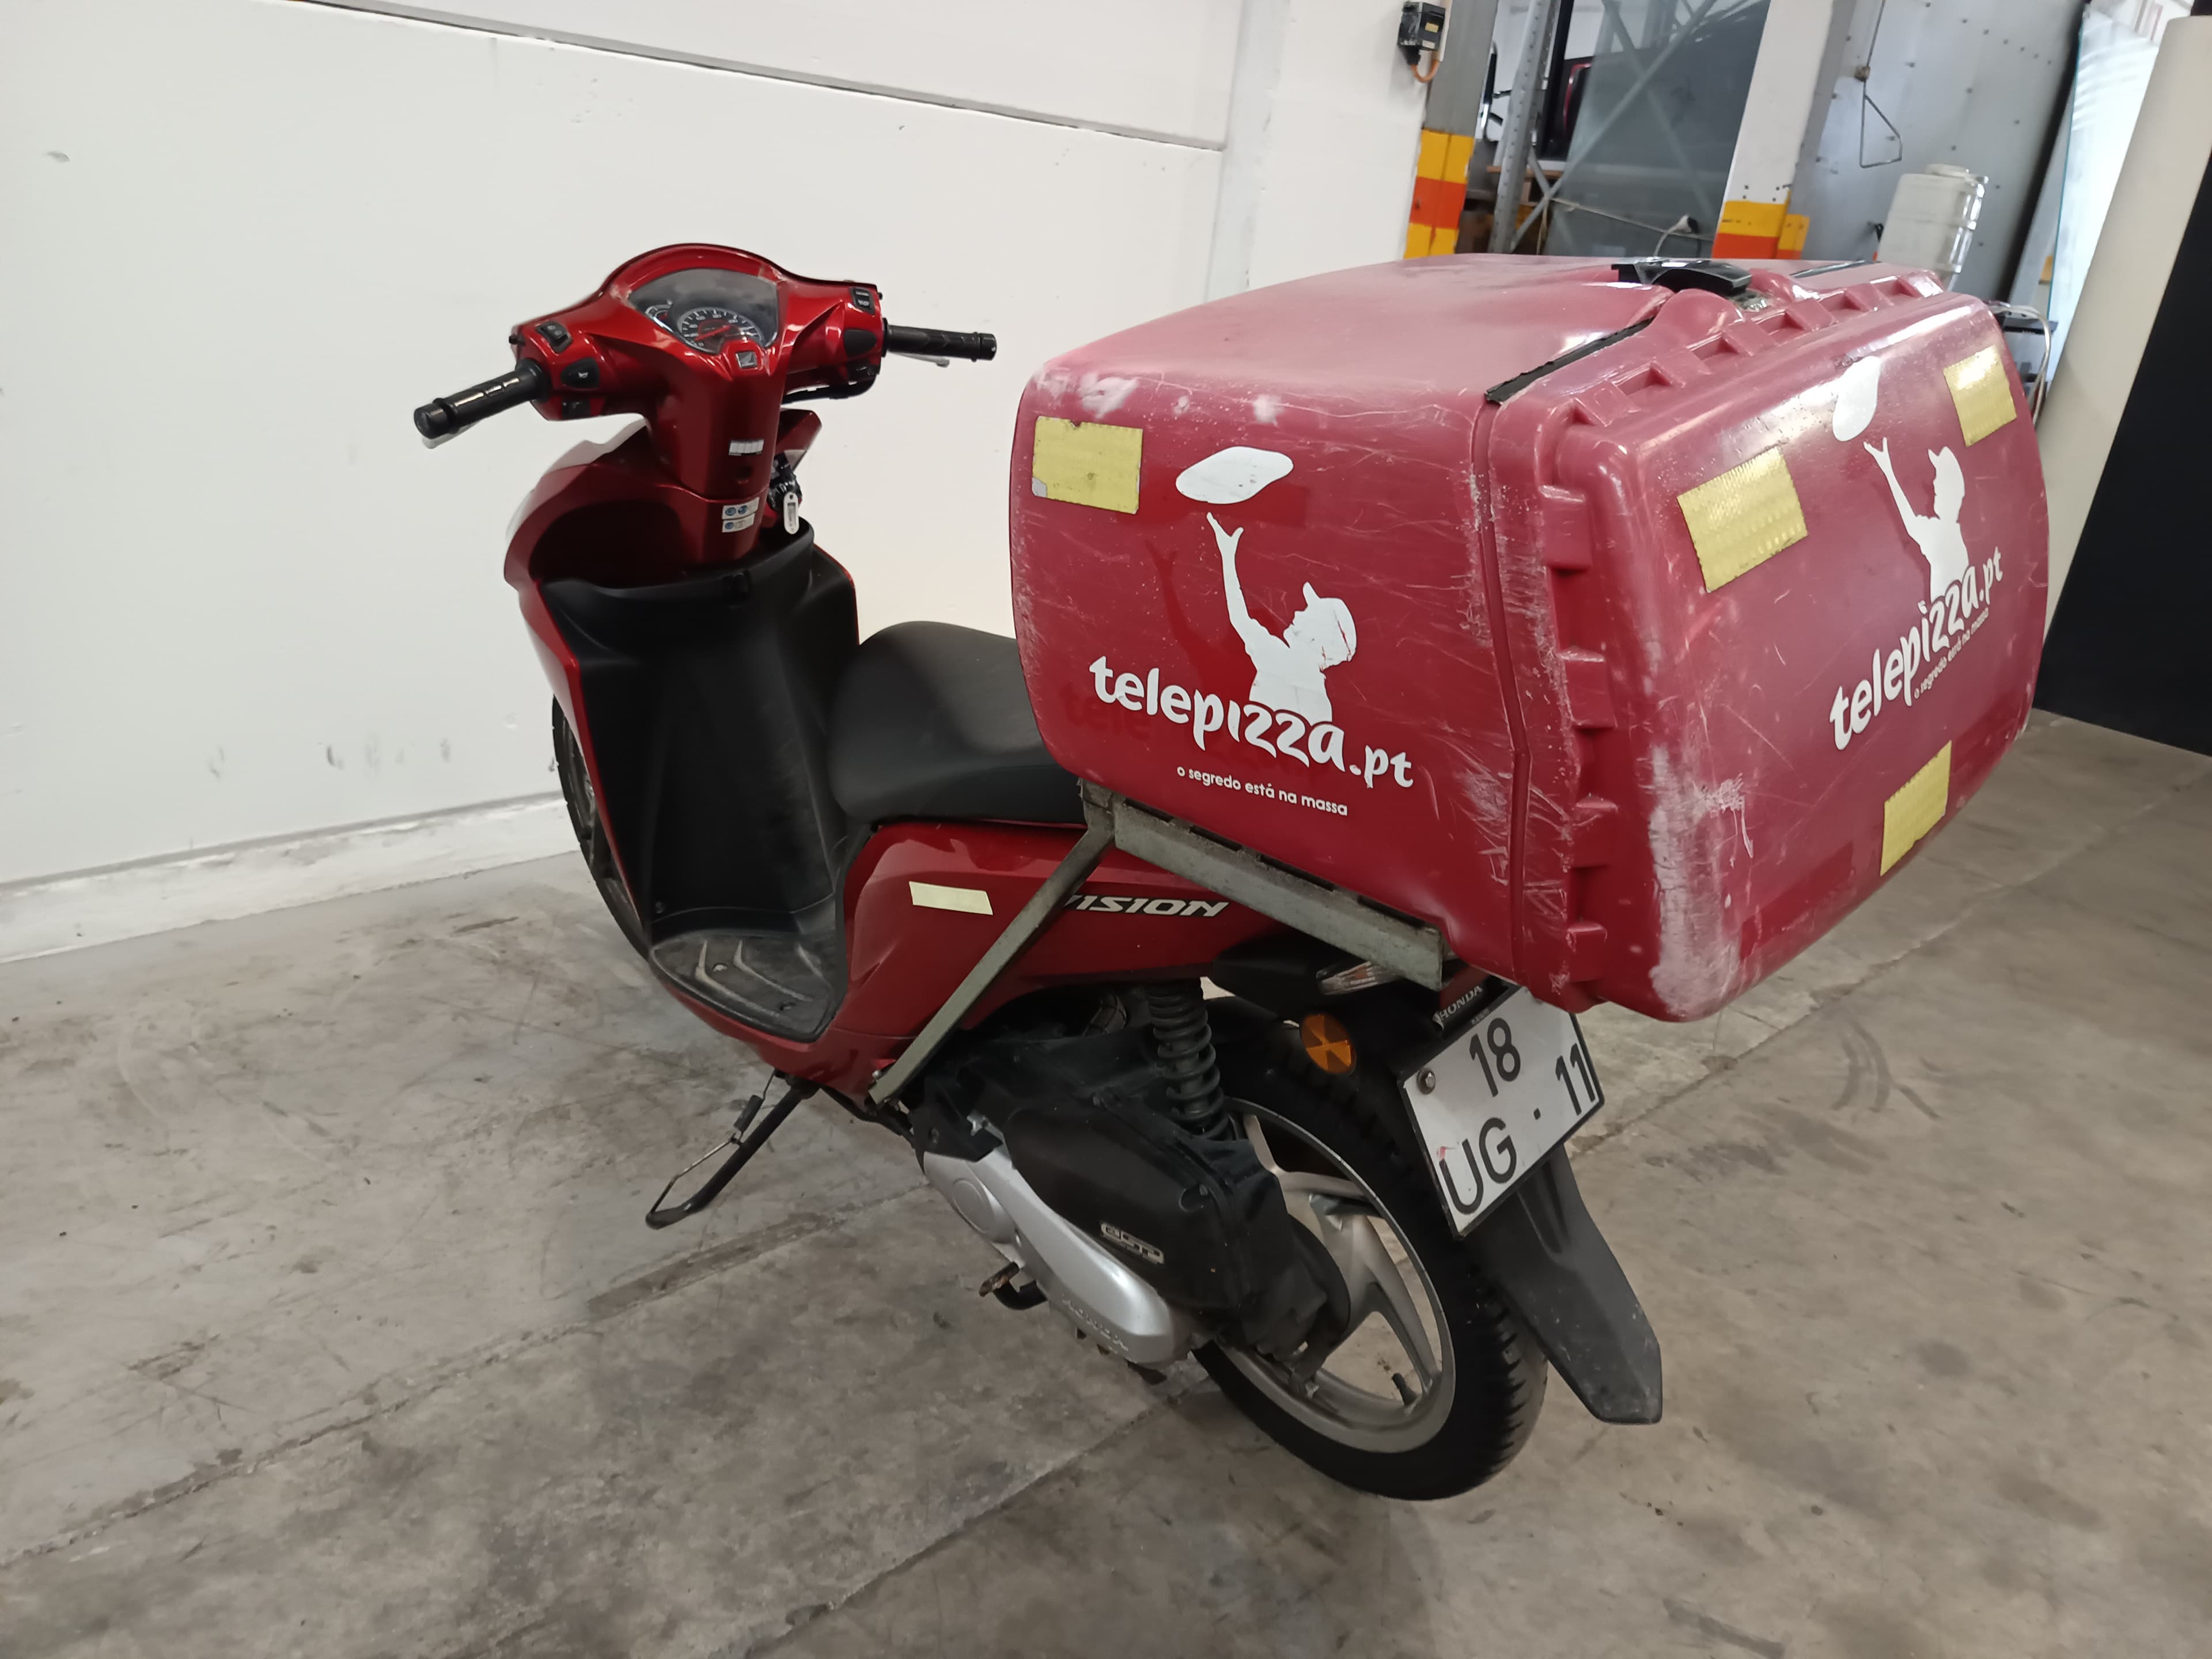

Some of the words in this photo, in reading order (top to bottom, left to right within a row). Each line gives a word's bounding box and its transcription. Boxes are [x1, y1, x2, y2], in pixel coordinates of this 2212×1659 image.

[1830, 546, 2003, 750] telepizza.pt
[1089, 656, 1414, 788] telepizza.pt
[1177, 766, 1185, 777] o
[1188, 768, 1241, 790] segredo
[1245, 782, 1275, 798] está
[1279, 790, 1297, 804] na
[1301, 795, 1347, 816] massa
[1439, 986, 1483, 1021] HONDA
[1469, 1017, 1521, 1097] 18
[1439, 1117, 1517, 1215] UG
[1555, 1043, 1596, 1116] 11
